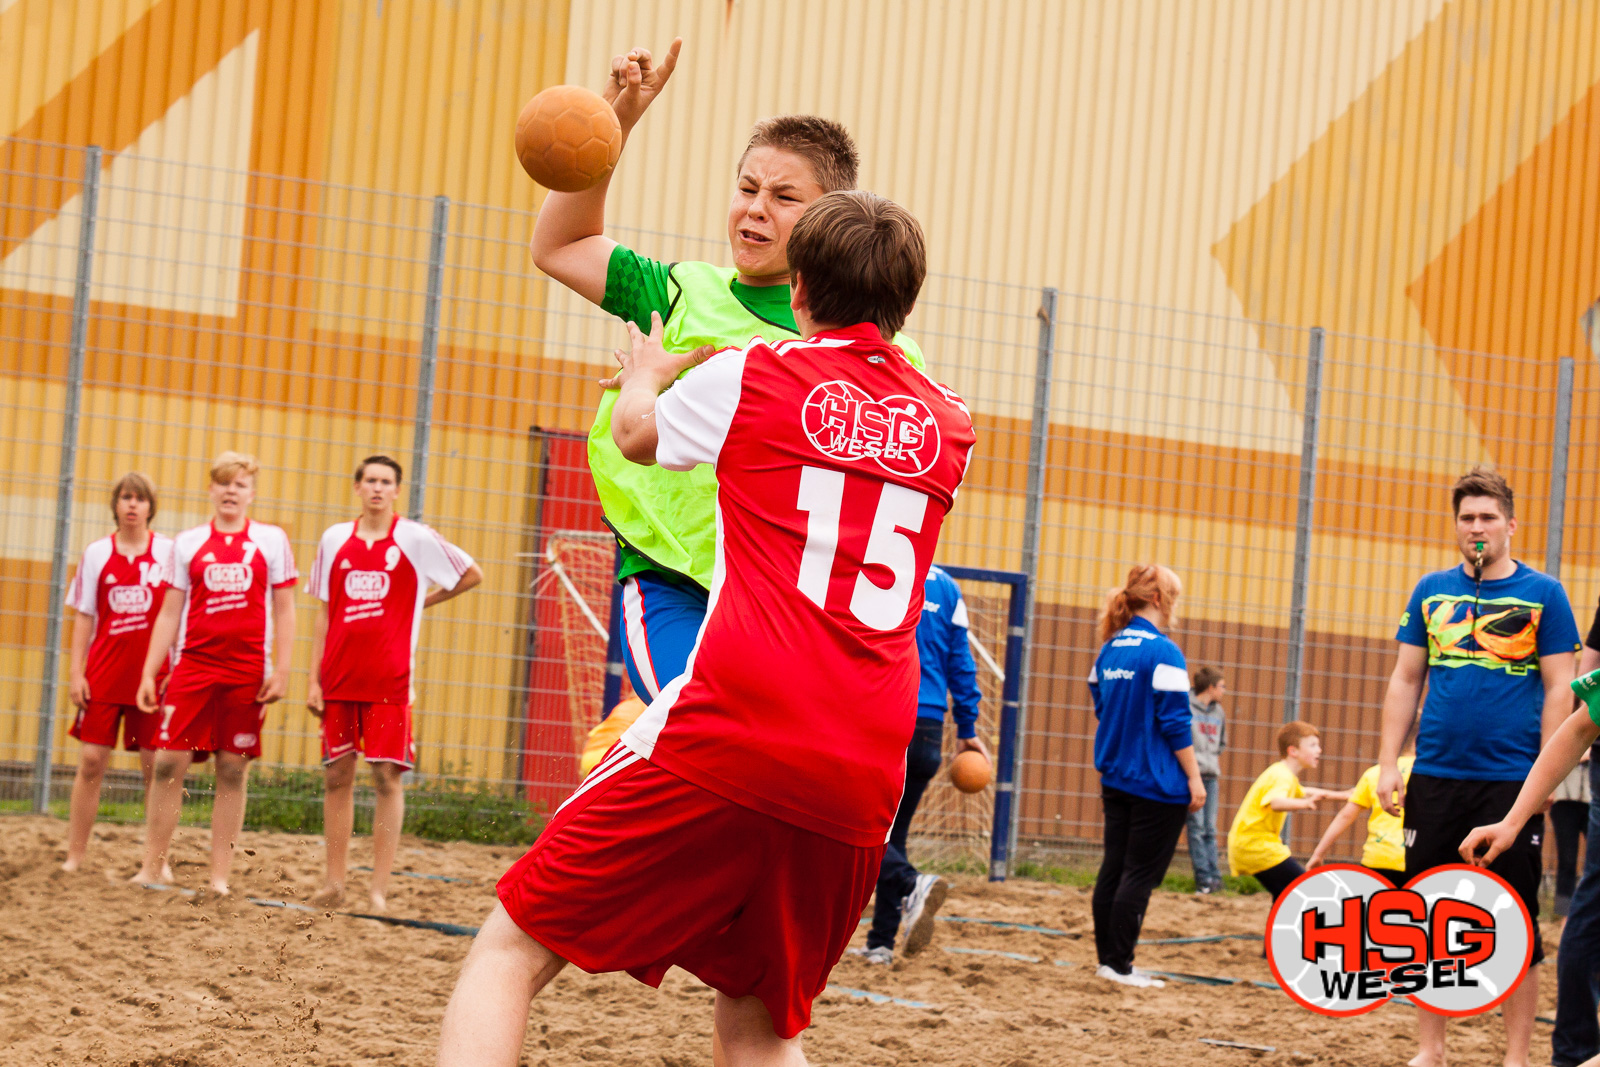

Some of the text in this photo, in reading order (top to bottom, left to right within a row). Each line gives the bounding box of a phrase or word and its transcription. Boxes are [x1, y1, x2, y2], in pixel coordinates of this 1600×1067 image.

[821, 398, 925, 451] HSG
[829, 431, 907, 461] WESEL
[242, 541, 258, 565] 7
[384, 545, 401, 571] 9
[796, 465, 929, 631] 15
